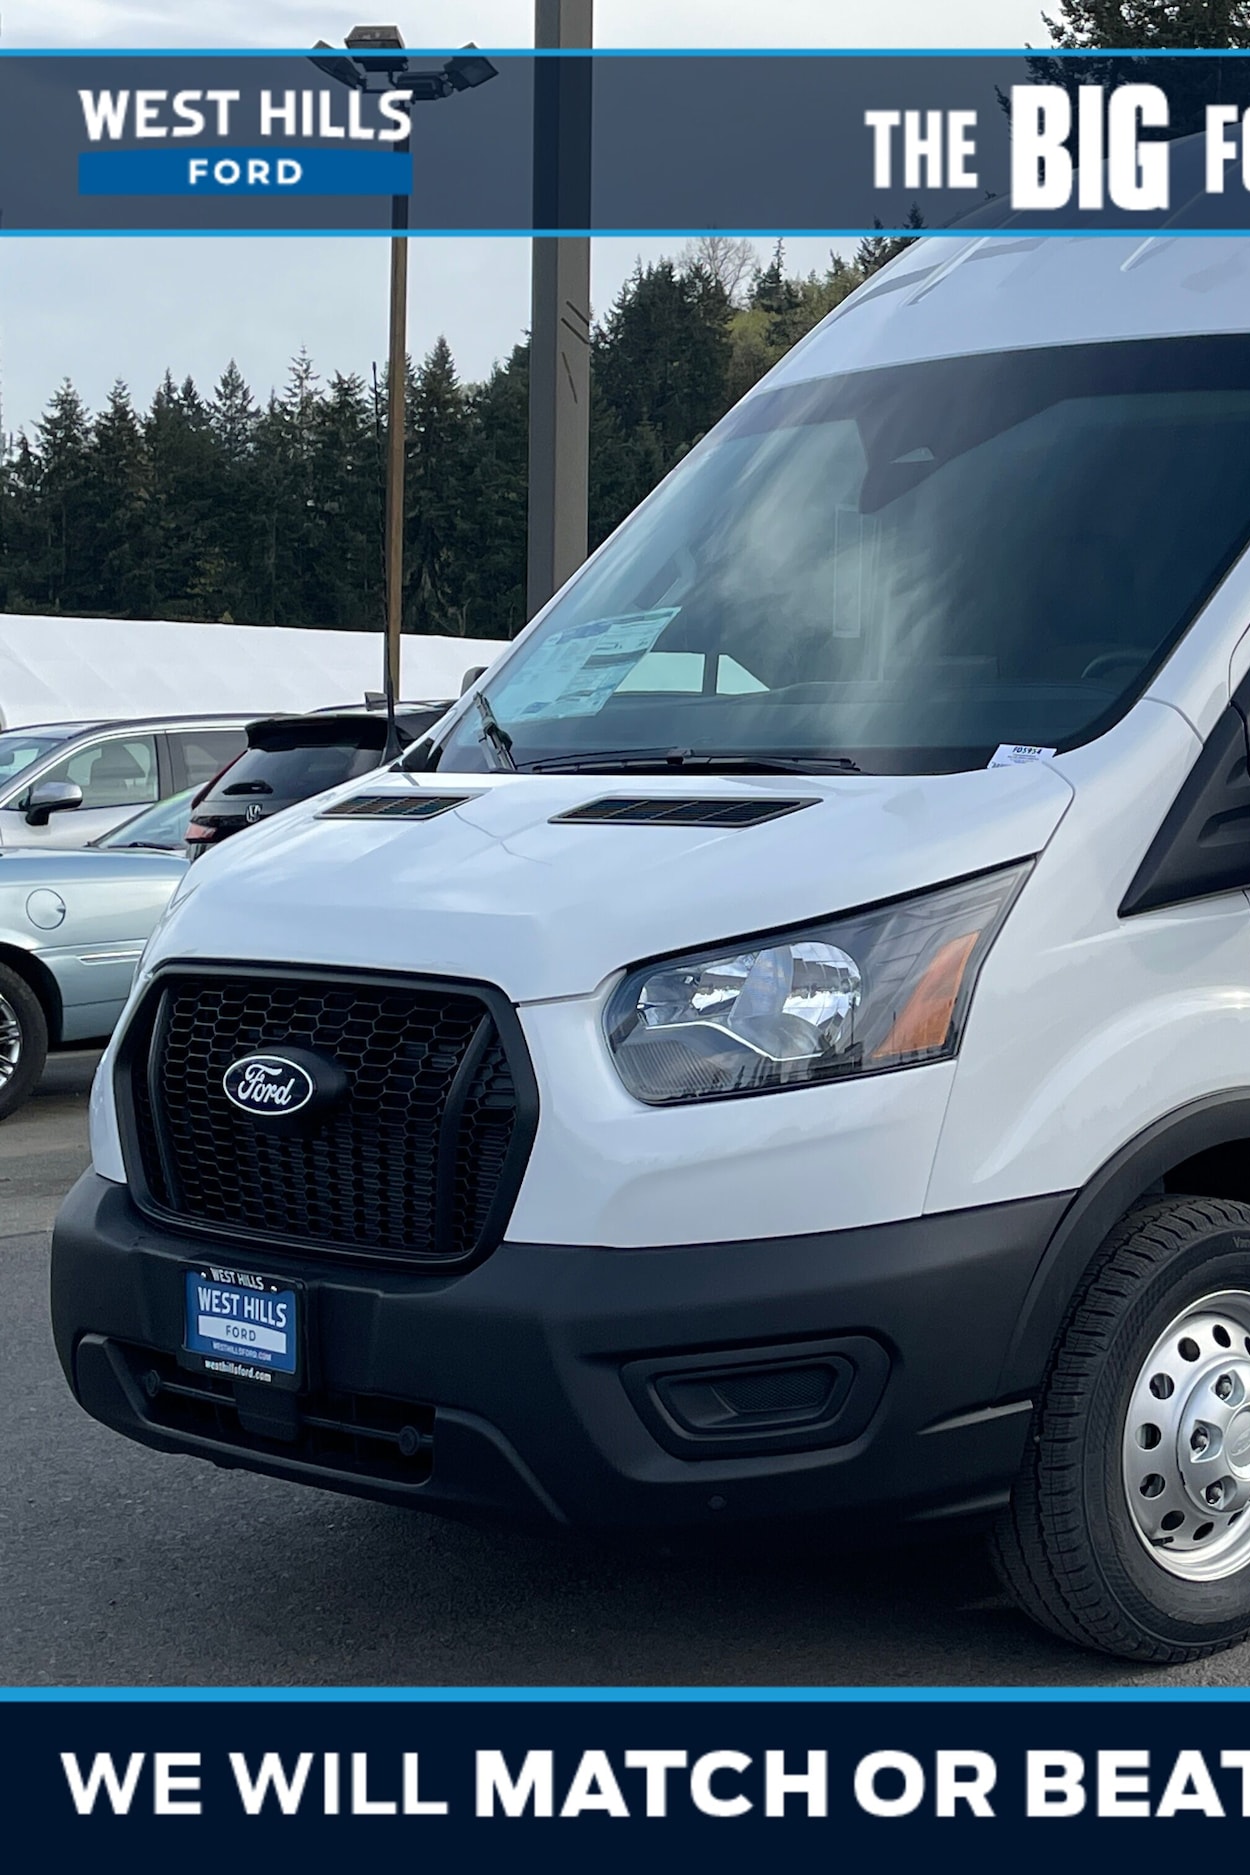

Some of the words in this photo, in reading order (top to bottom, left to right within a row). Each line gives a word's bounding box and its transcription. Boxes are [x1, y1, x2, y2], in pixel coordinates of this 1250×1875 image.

[237, 1063, 296, 1106] Ford
[210, 1268, 236, 1284] WEST
[237, 1273, 264, 1291] HILLS
[198, 1287, 240, 1316] WEST
[244, 1297, 288, 1328] HILLS
[226, 1325, 256, 1341] FORD
[205, 1359, 272, 1382] westhillsford.com
